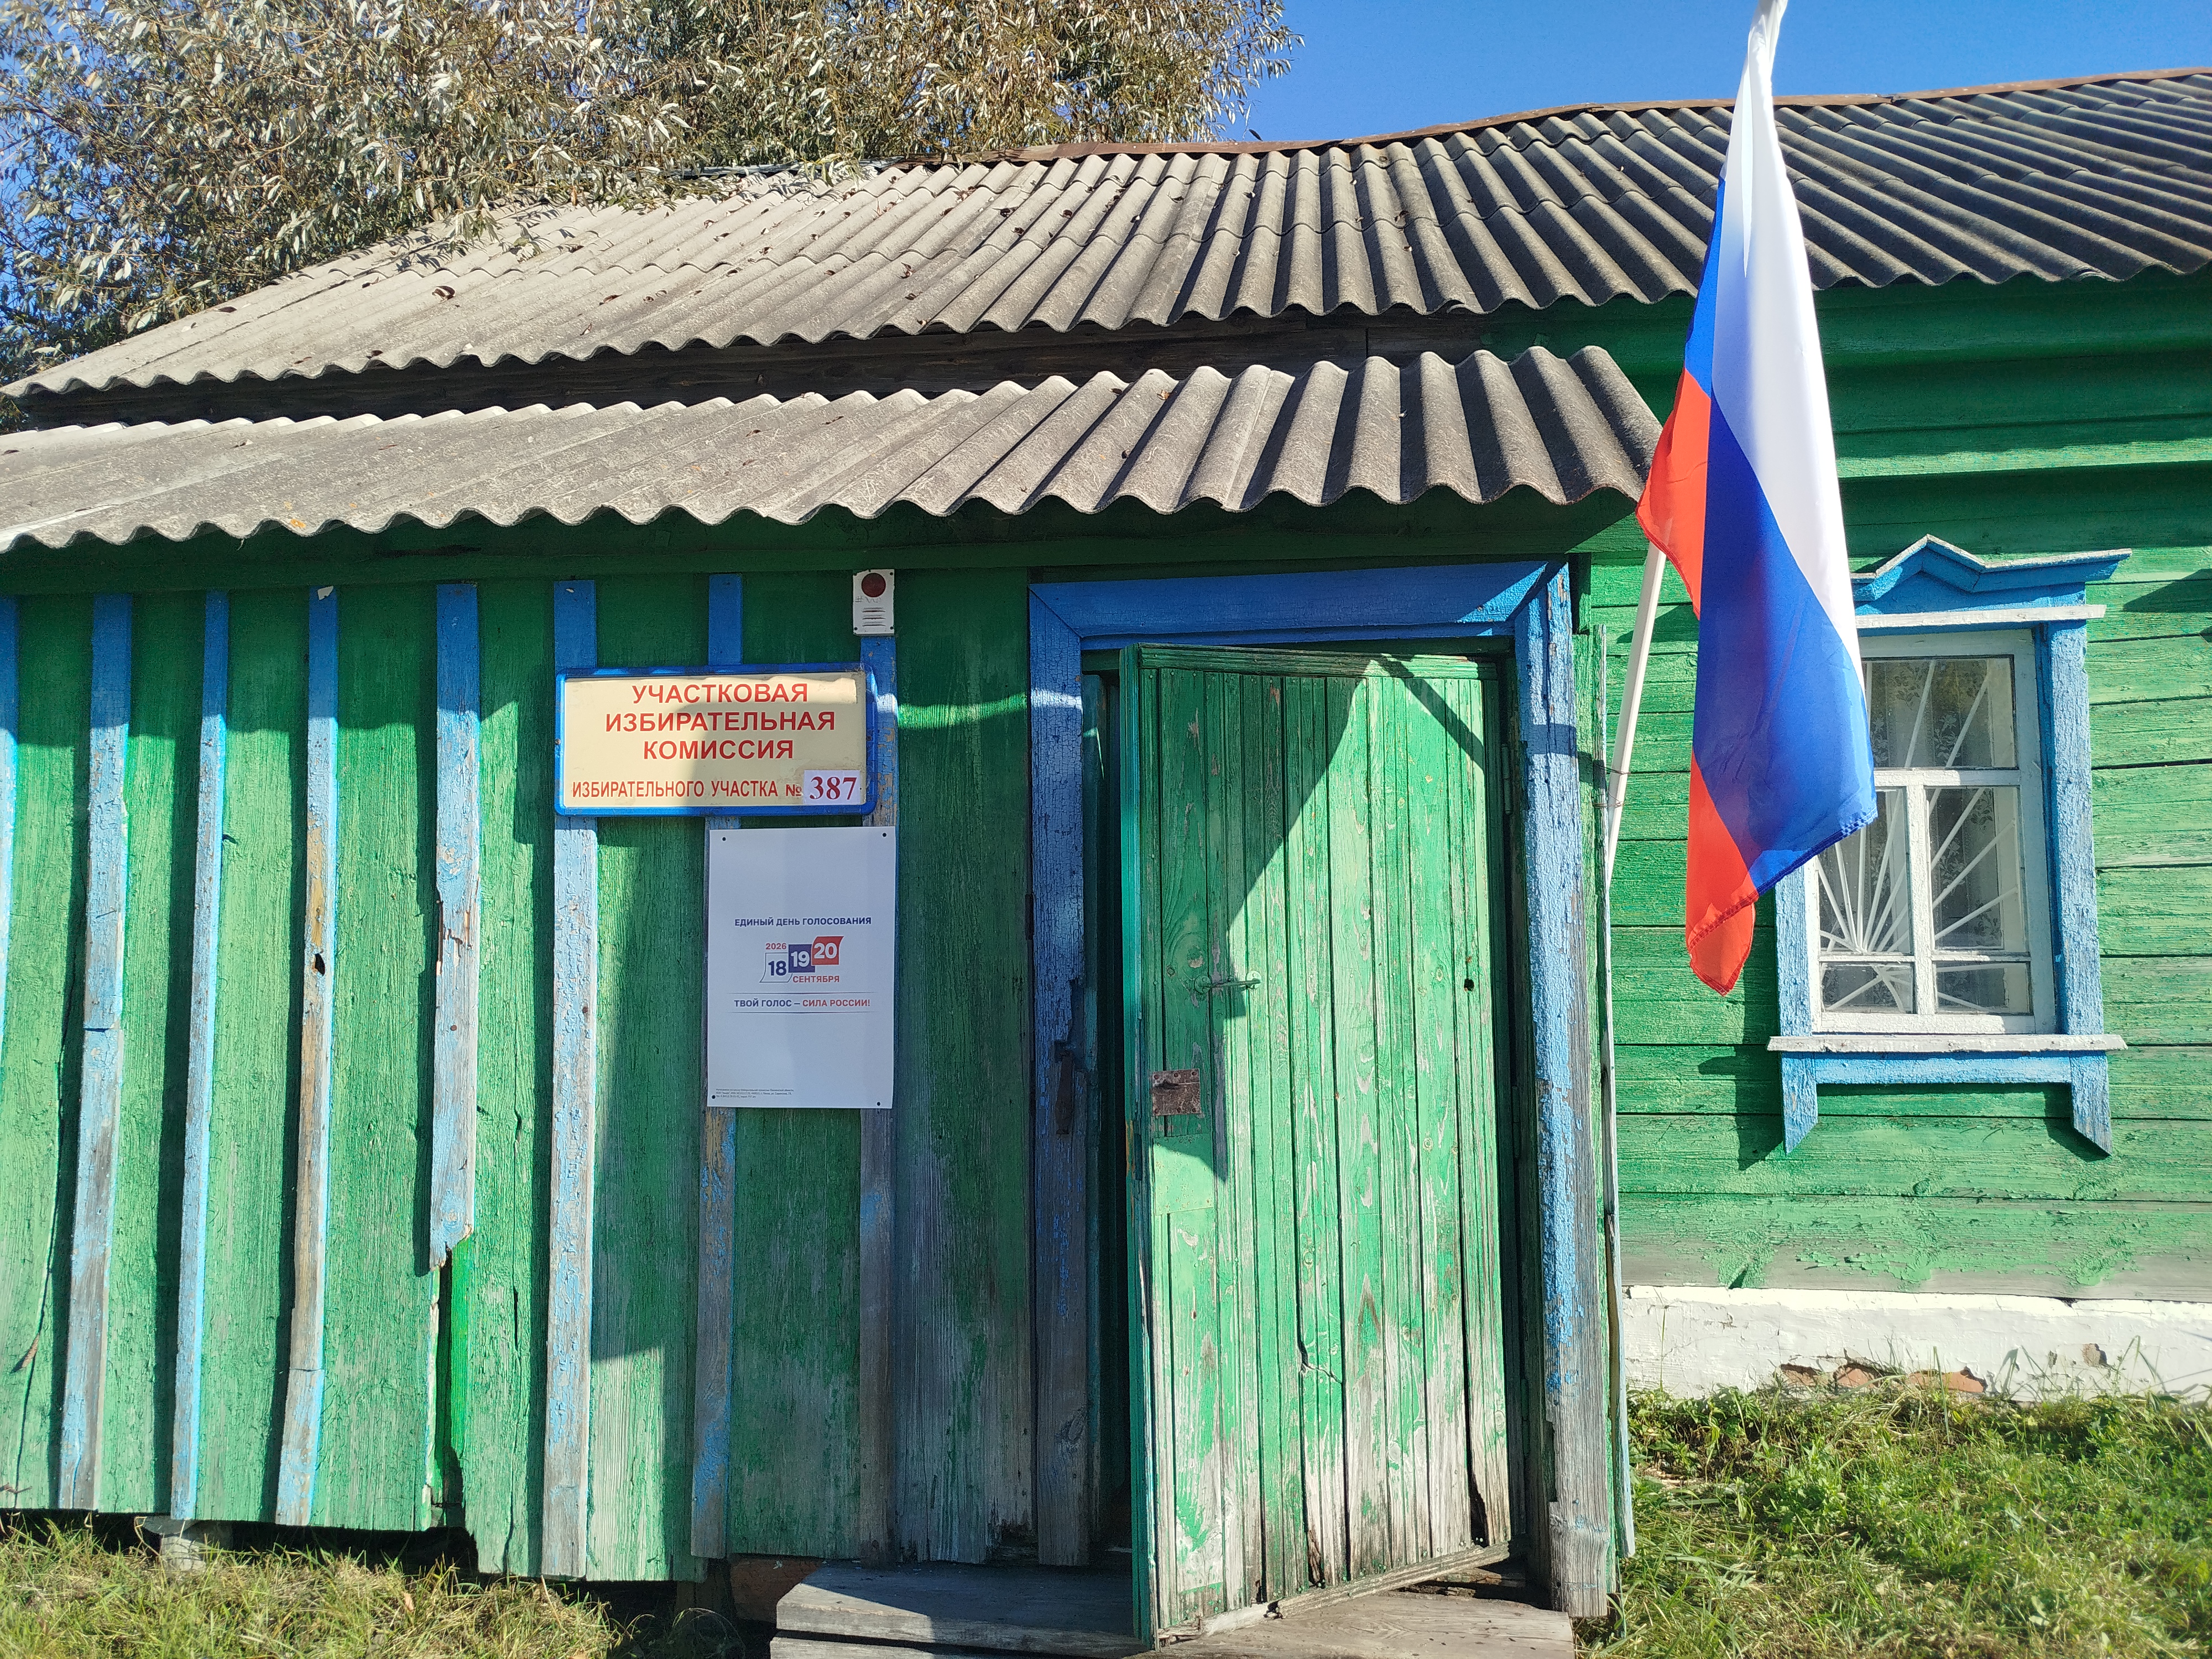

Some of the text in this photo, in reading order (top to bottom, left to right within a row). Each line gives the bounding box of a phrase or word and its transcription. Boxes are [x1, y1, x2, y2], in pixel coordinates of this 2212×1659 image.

[632, 684, 807, 703] УЧАСТКОВАЯ
[606, 711, 835, 732] ИЗБИРАТЕЛЬНАЯ
[644, 740, 793, 759] КОМИССИЯ
[572, 776, 857, 800] ИЗБИРАТЕЛЬНОГО УЧАСТКА № 387
[735, 917, 774, 927] ЕДИНЫЙ
[776, 918, 800, 926] ДЕНЬ
[768, 943, 837, 975] 18 19 20
[734, 998, 759, 1007] ТВОЙ
